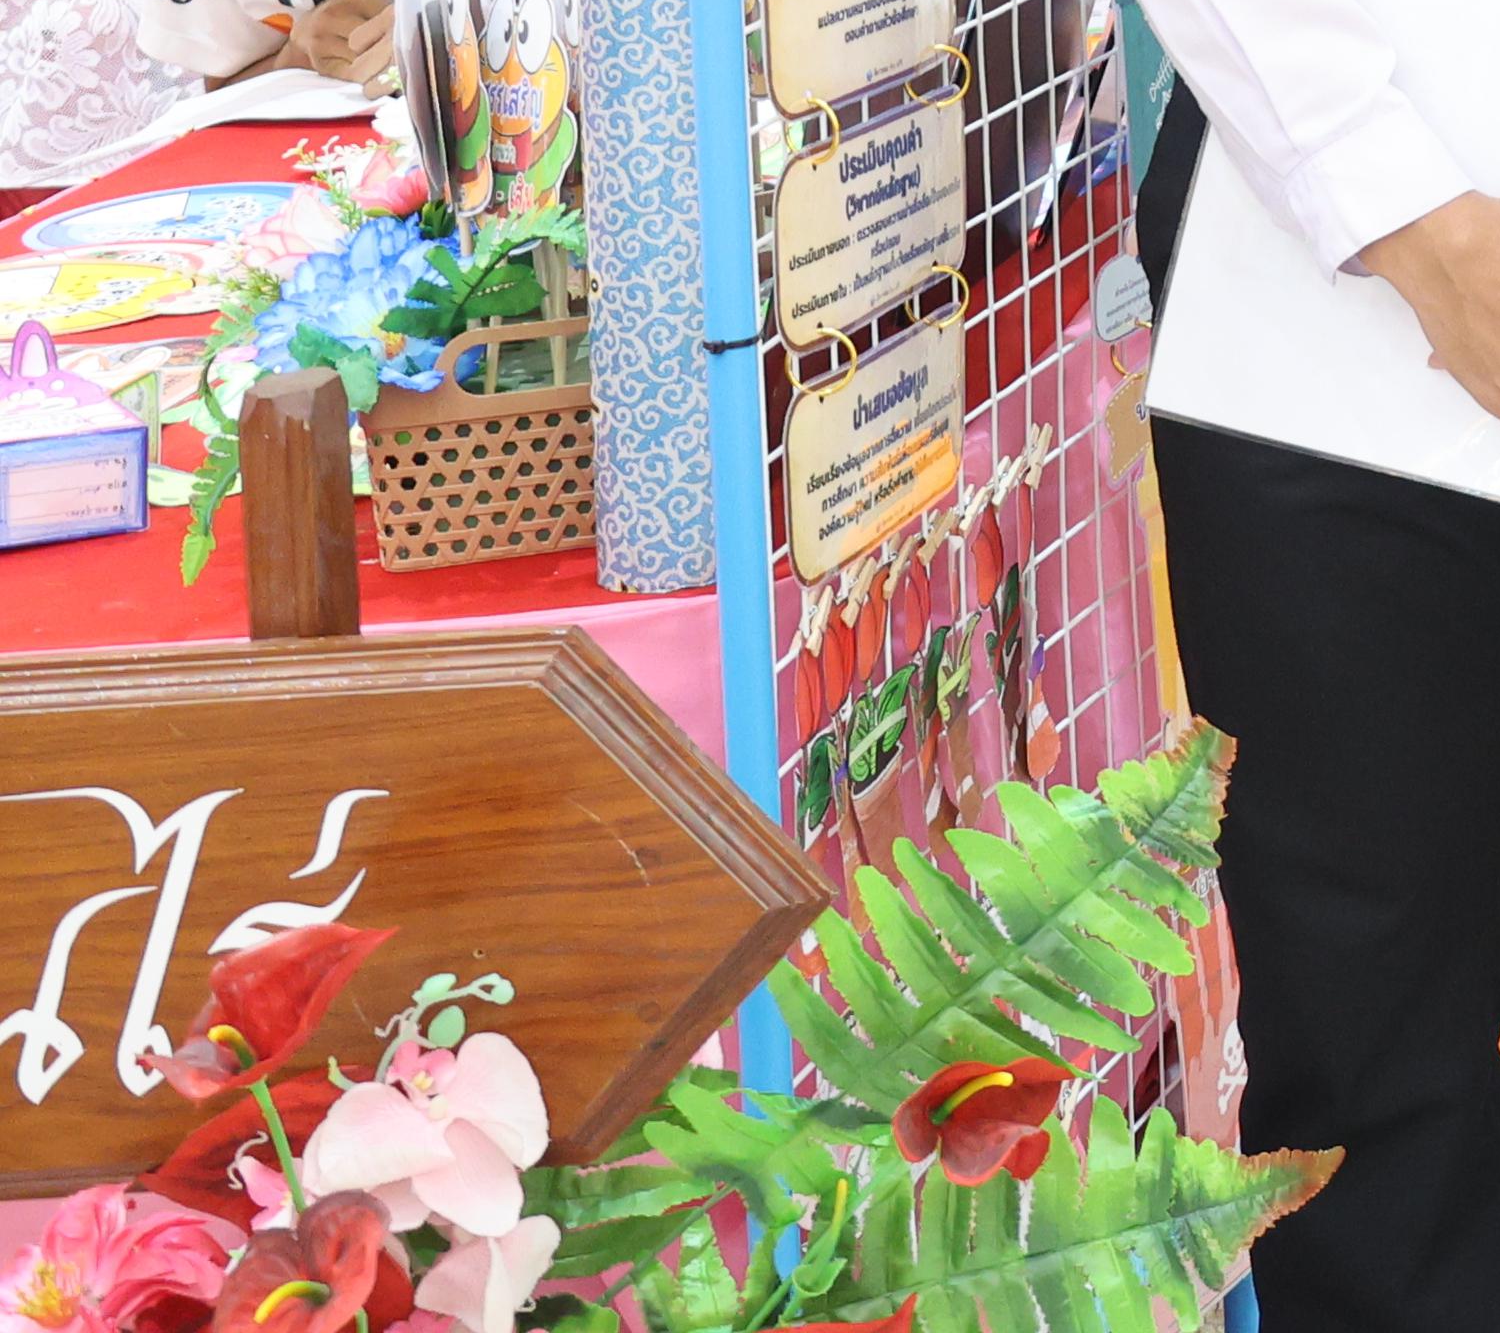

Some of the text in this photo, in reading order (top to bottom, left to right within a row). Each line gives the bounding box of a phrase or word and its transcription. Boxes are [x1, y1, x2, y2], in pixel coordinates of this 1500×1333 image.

[839, 119, 923, 183] ประเมินคุณค่า
